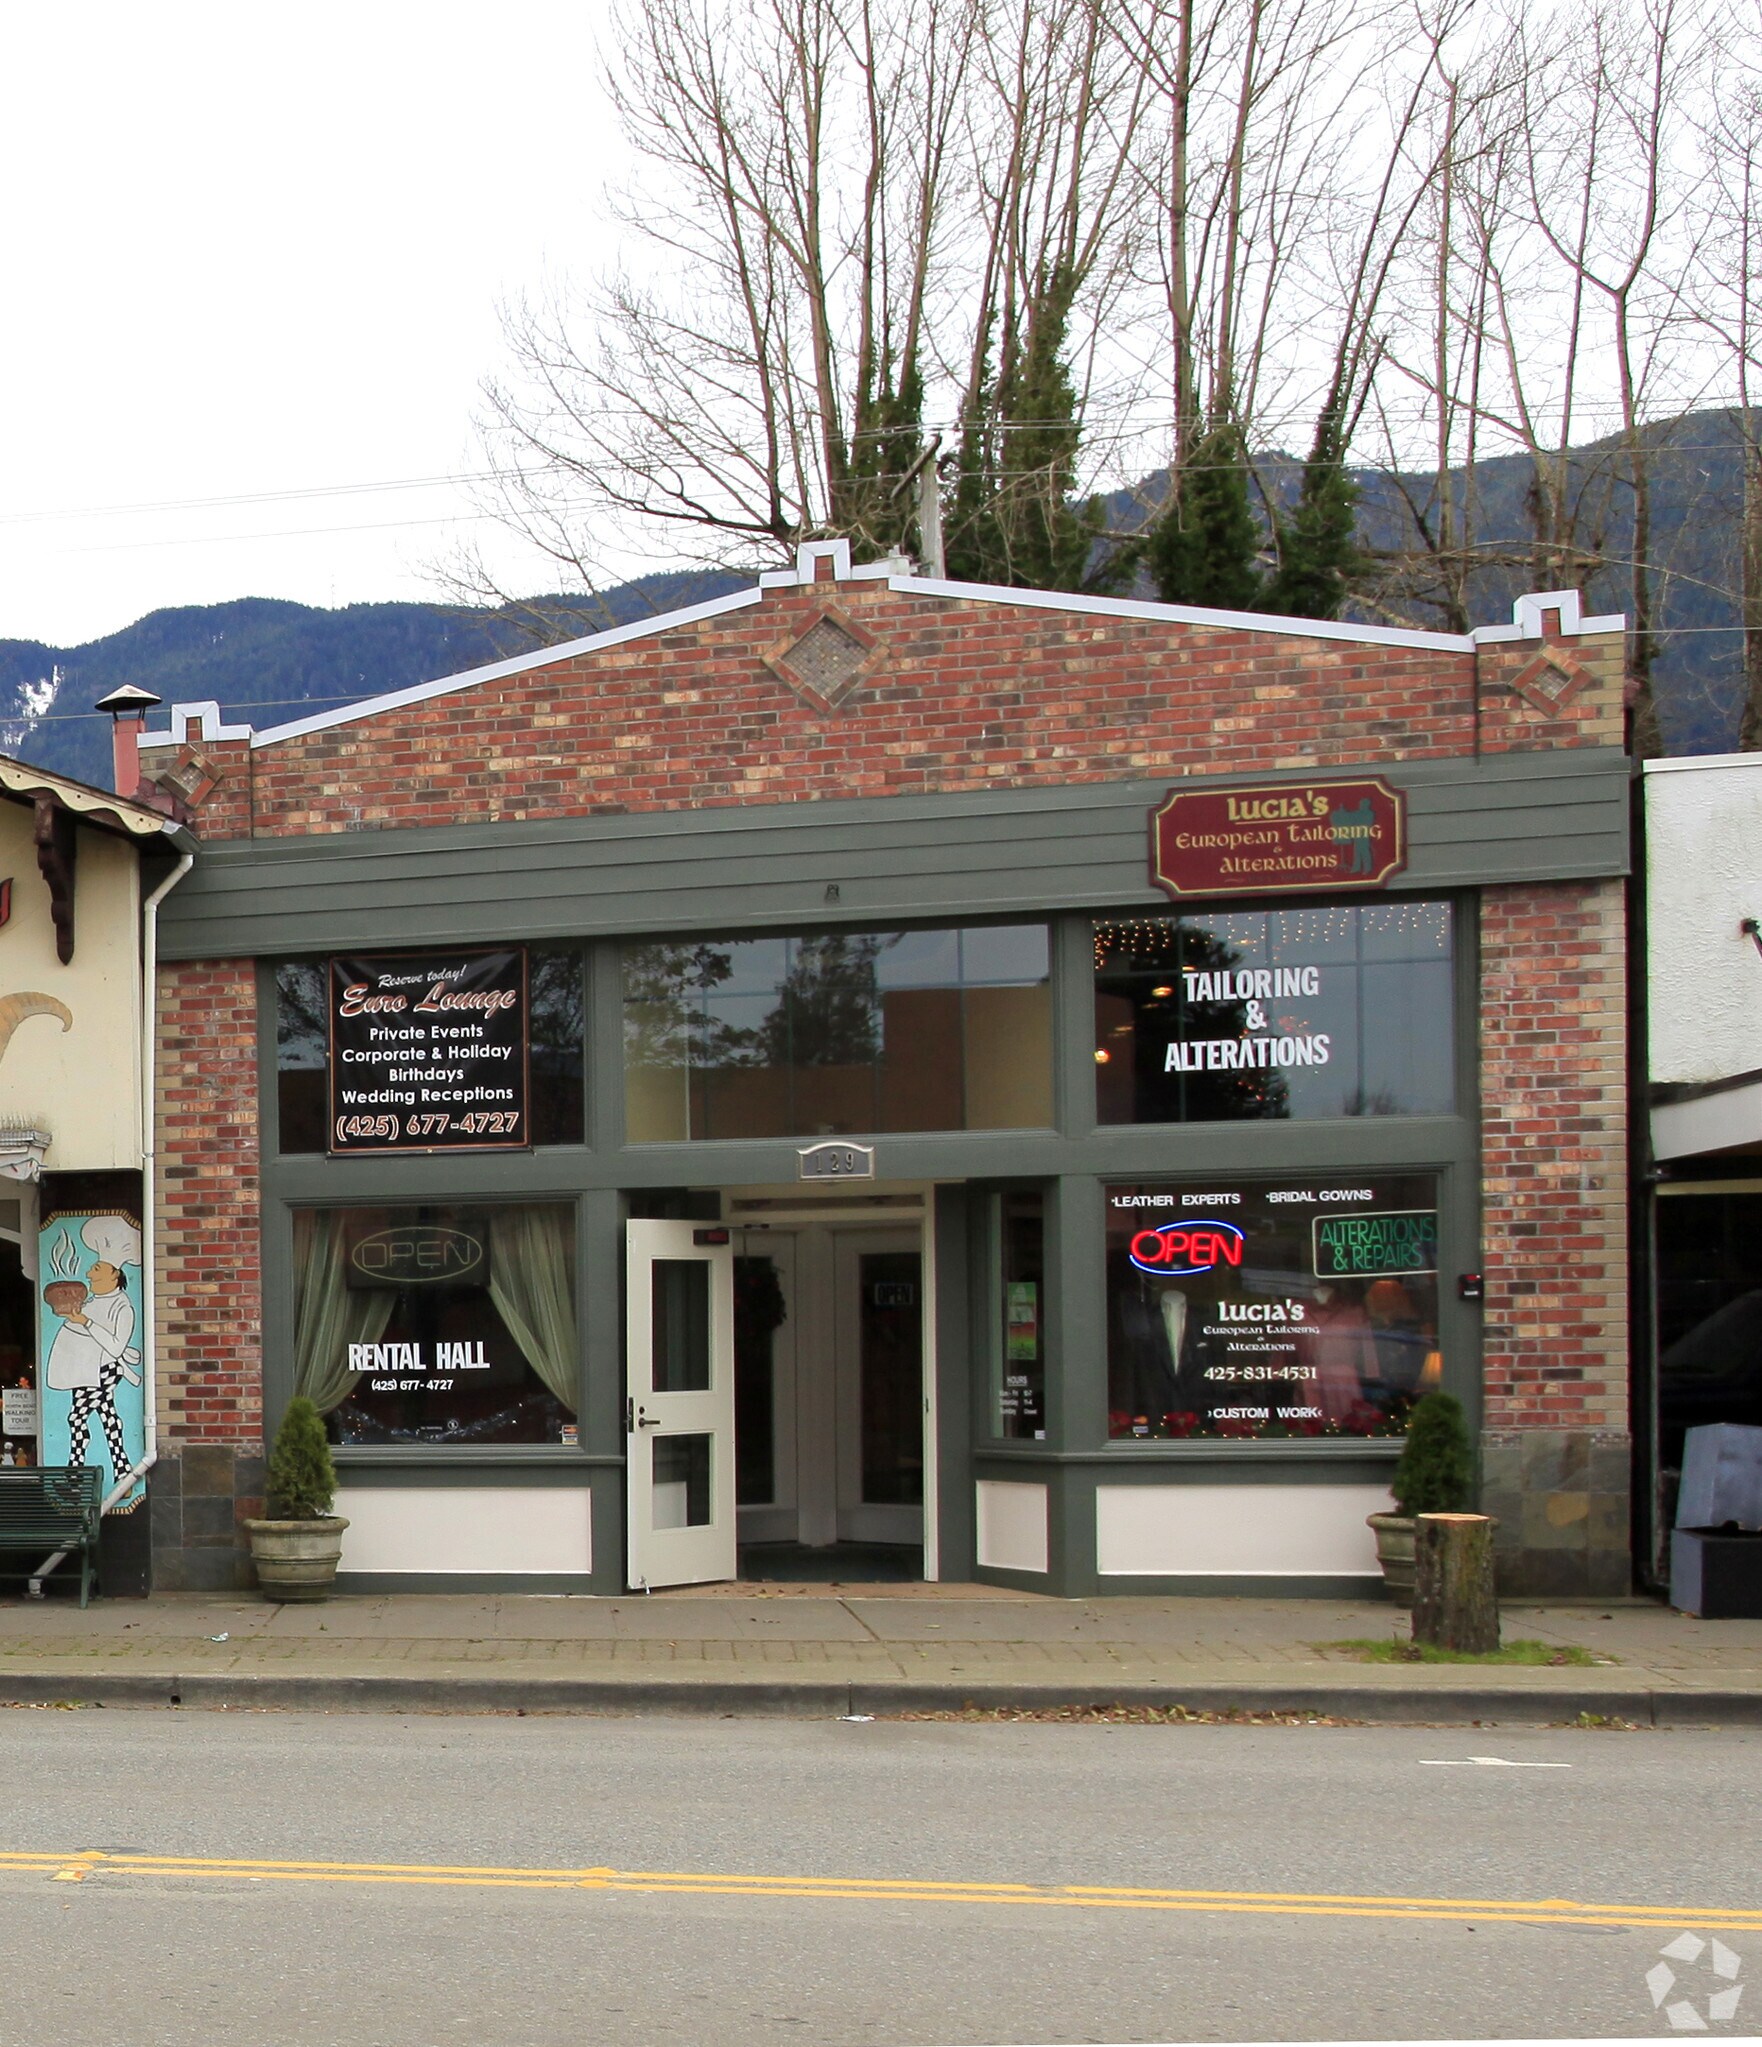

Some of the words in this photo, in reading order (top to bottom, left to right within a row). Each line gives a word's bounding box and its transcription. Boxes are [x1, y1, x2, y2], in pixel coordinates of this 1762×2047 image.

[1227, 790, 1329, 821] Lucia's
[1175, 830, 1279, 850] European
[1287, 824, 1382, 842] Tailoring
[1219, 854, 1338, 873] Alterations
[378, 974, 423, 988] Reserve
[427, 964, 467, 982] today!
[1182, 966, 1319, 1002] TAILORING
[340, 982, 408, 1017] Euro
[413, 981, 516, 1019] Lounge
[1245, 999, 1267, 1030] &
[370, 1027, 425, 1041] Private
[431, 1024, 484, 1039] Events
[342, 1047, 426, 1064] Corporate
[432, 1048, 442, 1060] &
[448, 1044, 512, 1063] Holiday
[1164, 1034, 1330, 1072] ALTERATIONS
[389, 1067, 464, 1083] Birthdays
[342, 1090, 415, 1105] Wedding
[421, 1087, 514, 1103] Receptions
[336, 1114, 399, 1141] (425)
[406, 1112, 520, 1135] 677-4727
[816, 1152, 854, 1172] 129
[1181, 1193, 1241, 1206] EXPERTS
[1319, 1190, 1372, 1201] GOWNS
[1320, 1217, 1434, 1247] ALTERATIONS
[362, 1240, 472, 1268] OPEN
[1130, 1230, 1243, 1266] OPEN
[1332, 1250, 1348, 1271] &
[1353, 1242, 1423, 1269] REPAIRS
[878, 1285, 911, 1304] OPEN
[1218, 1299, 1305, 1321] Lucia's
[1203, 1326, 1263, 1336] European
[1266, 1325, 1320, 1335] Tailoring
[348, 1342, 426, 1371] RENTAL
[436, 1341, 491, 1370] HALL
[1227, 1342, 1296, 1352] Alterations
[1204, 1366, 1318, 1381] 425-831-4531
[371, 1379, 397, 1391] (425)
